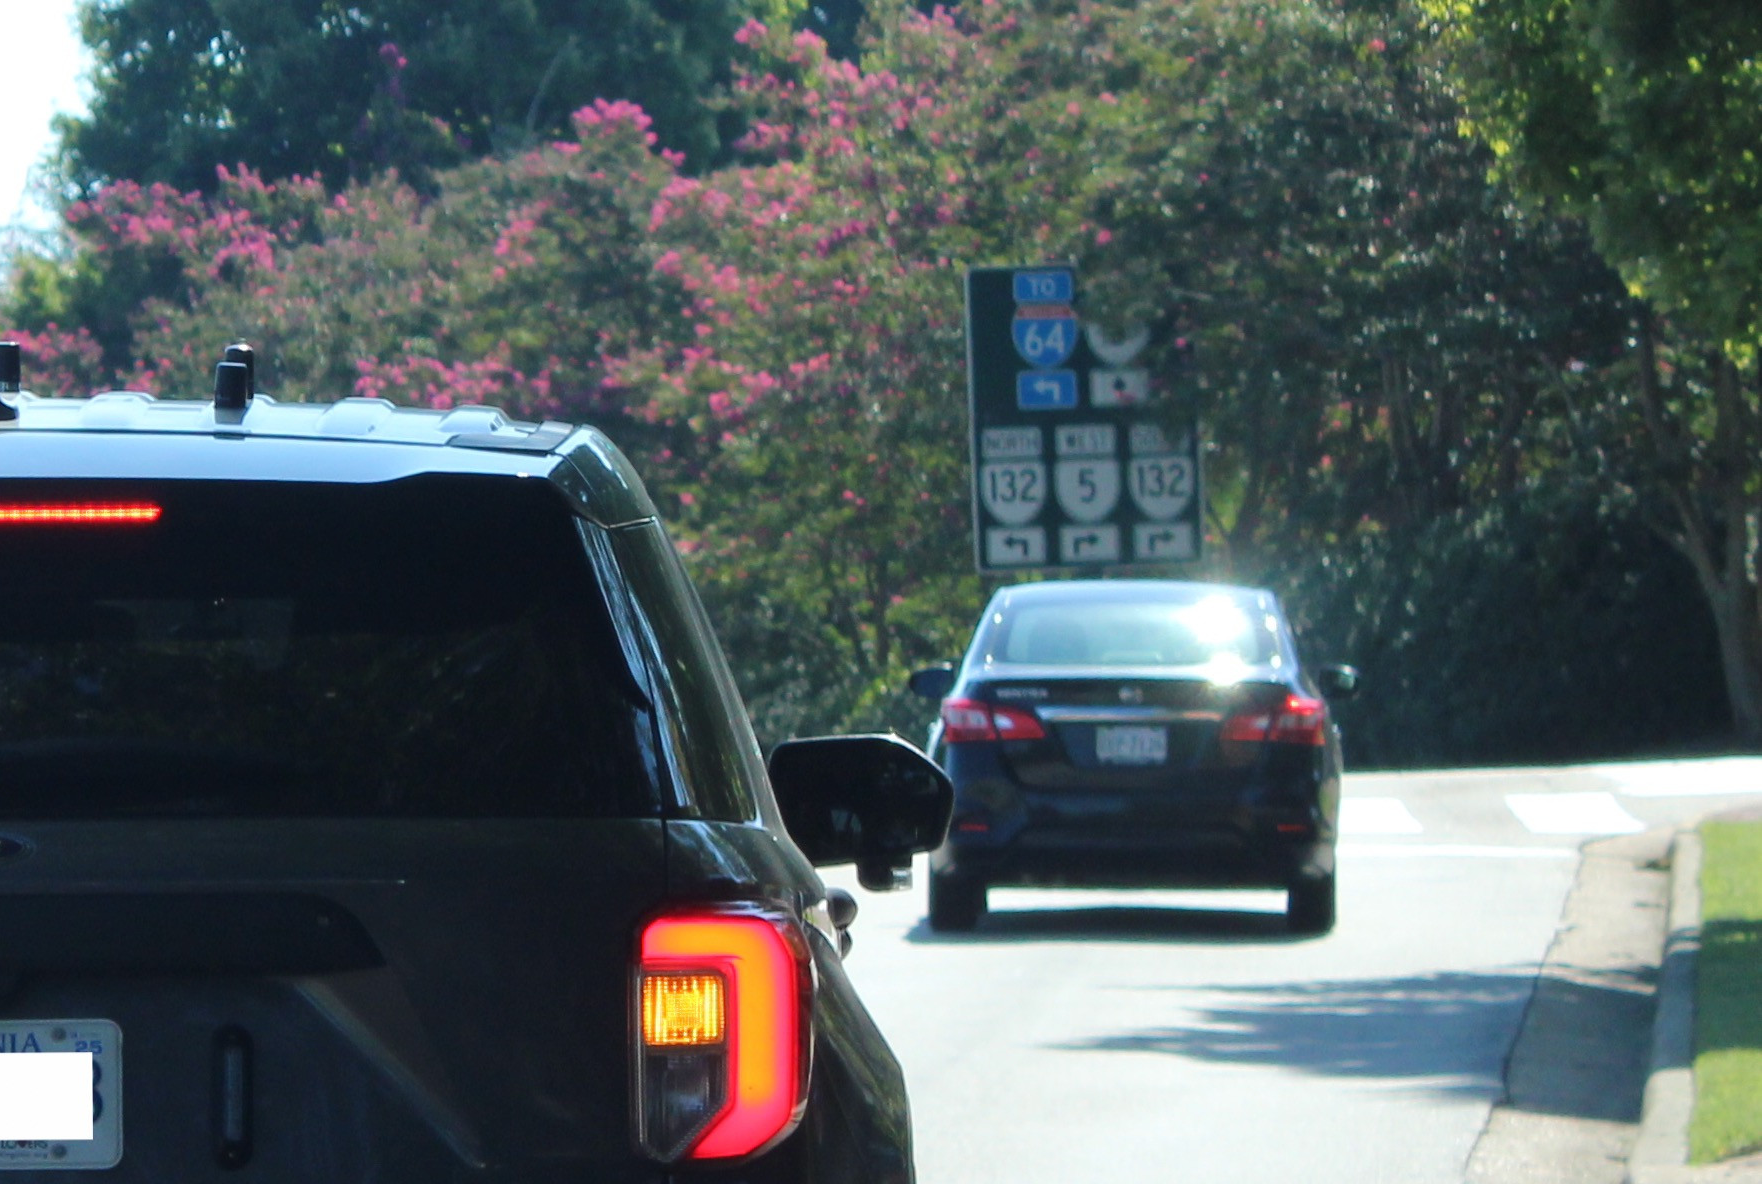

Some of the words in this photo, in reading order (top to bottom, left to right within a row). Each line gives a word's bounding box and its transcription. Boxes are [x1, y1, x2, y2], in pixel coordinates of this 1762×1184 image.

[1028, 277, 1056, 296] TO
[1024, 322, 1066, 357] 64
[990, 469, 1037, 502] 132
[1077, 468, 1097, 503] 5
[1138, 464, 1186, 499] 132
[75, 1040, 103, 1055] 25
